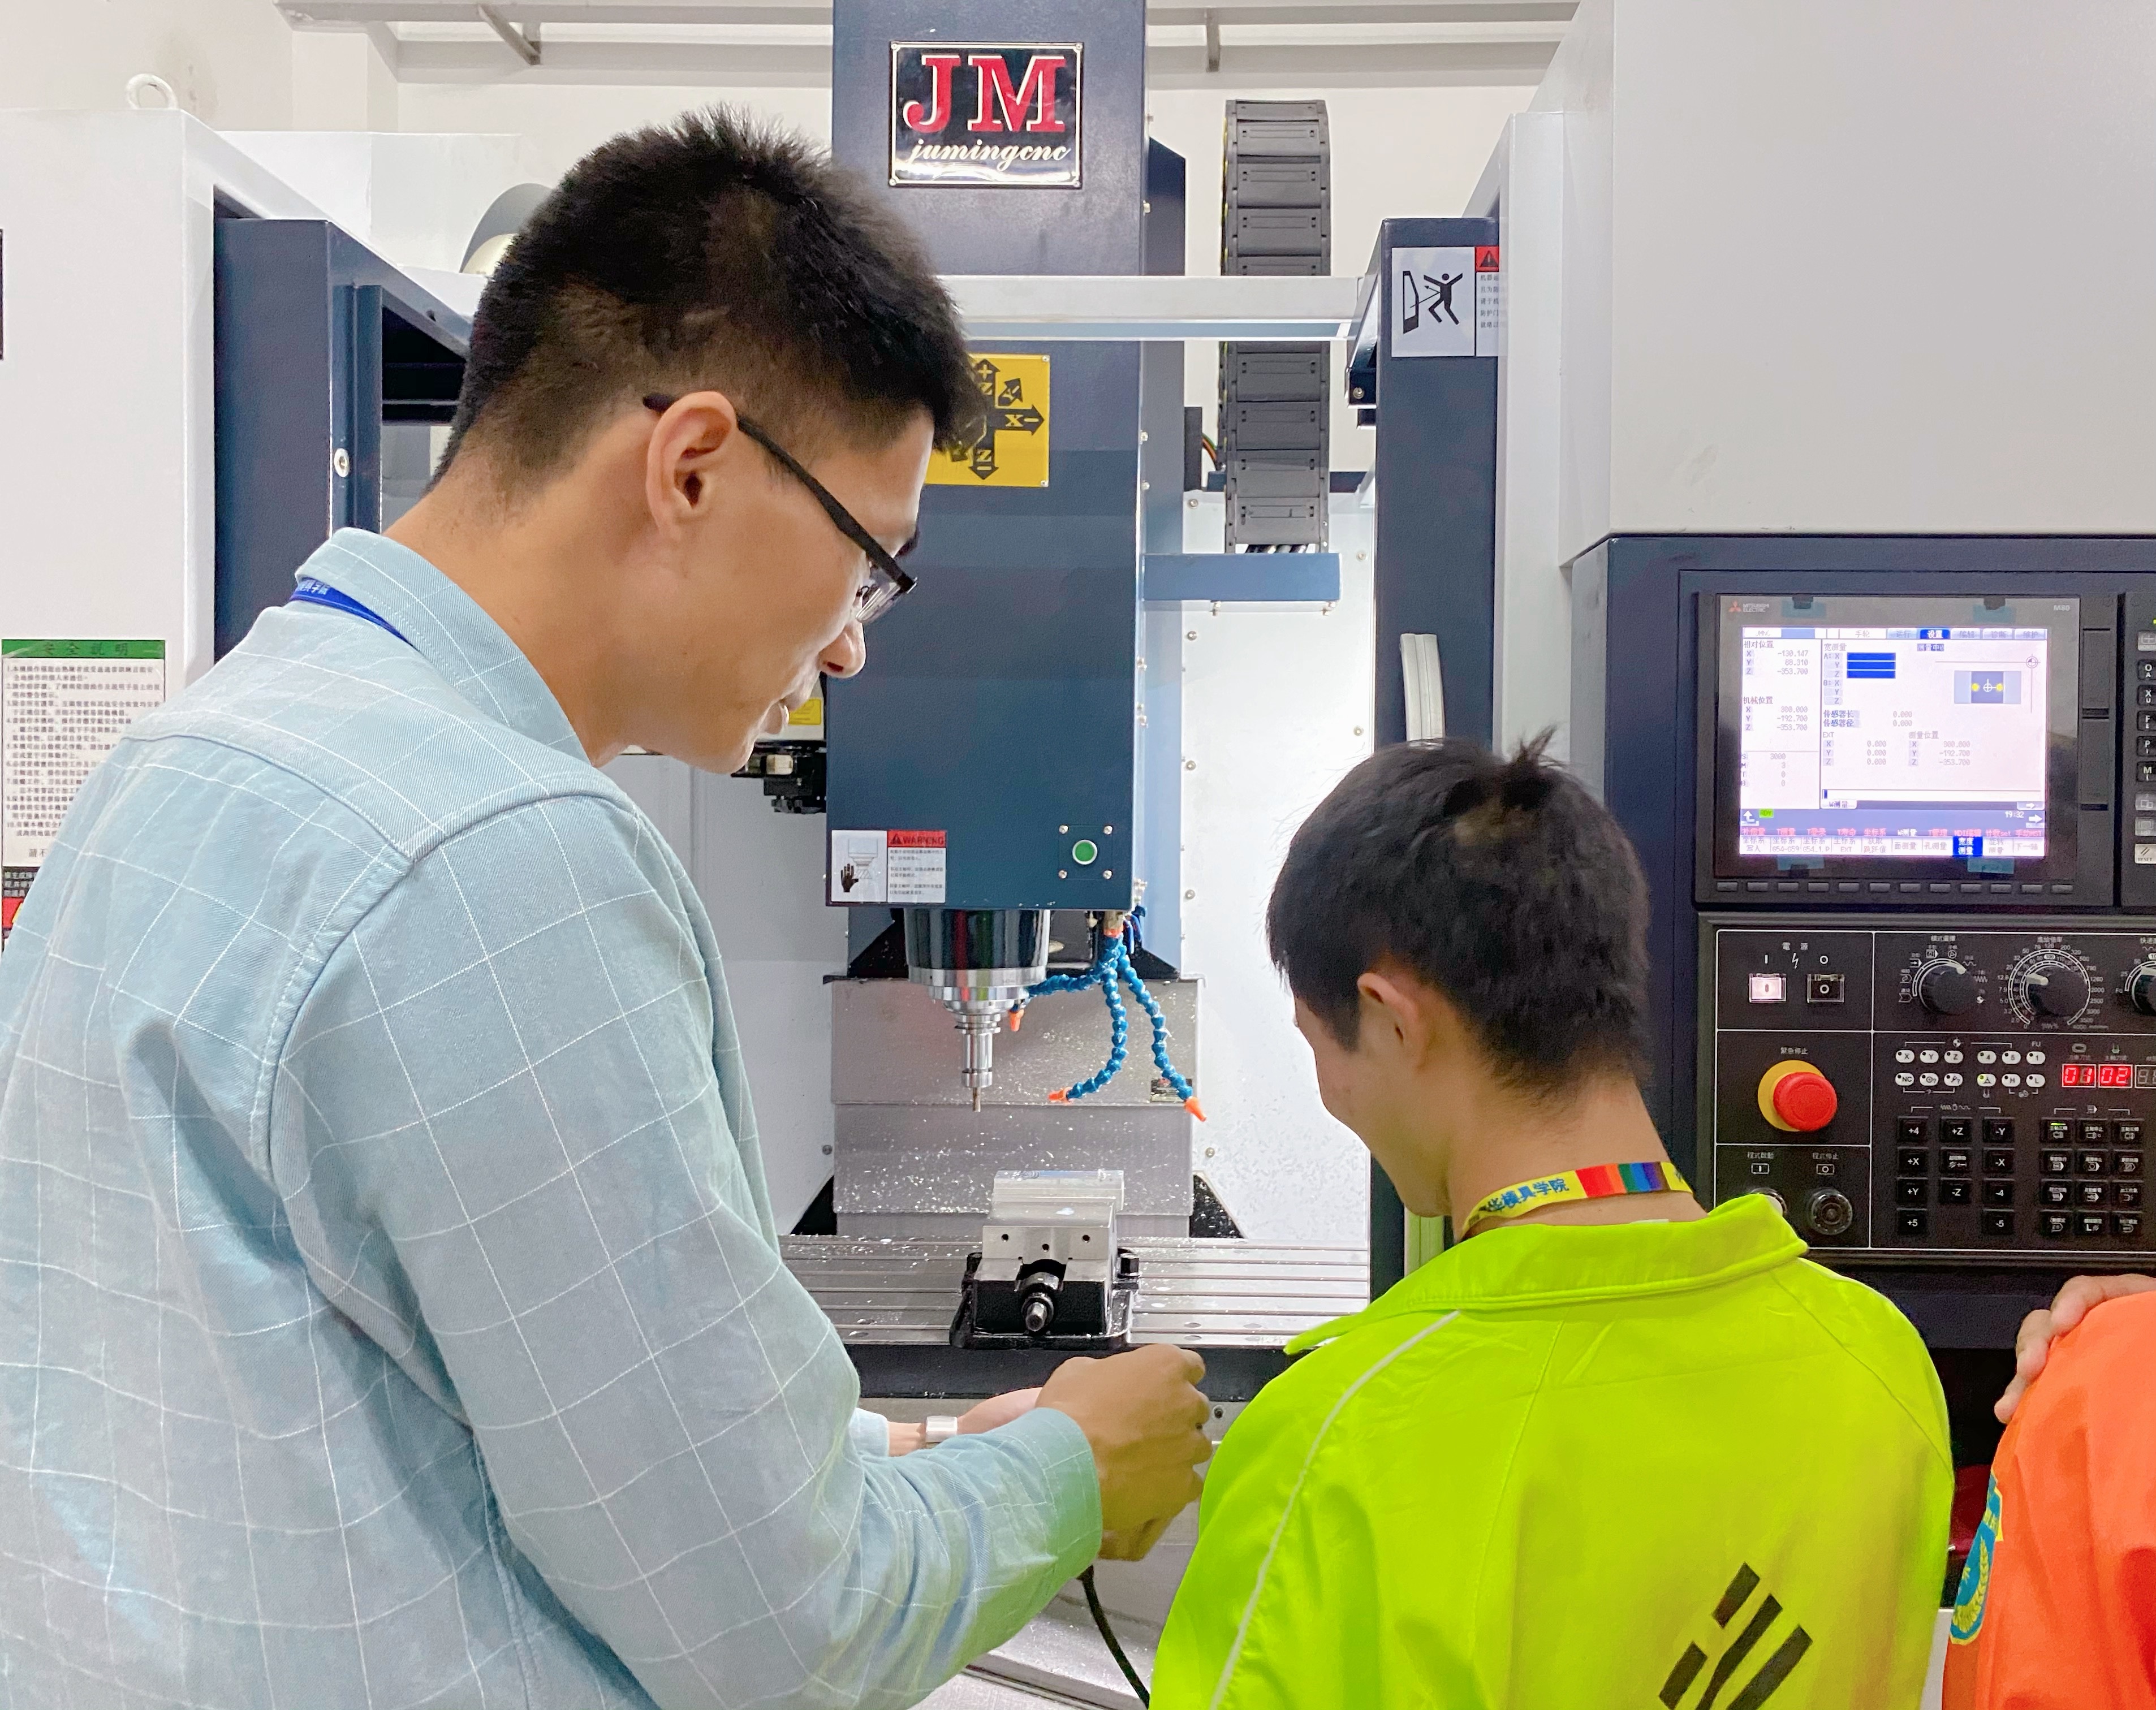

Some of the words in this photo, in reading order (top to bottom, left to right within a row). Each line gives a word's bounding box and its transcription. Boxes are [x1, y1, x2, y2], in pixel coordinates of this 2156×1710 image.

[903, 54, 1066, 133] JM
[909, 139, 1072, 172] jumingcnc
[1743, 640, 1774, 649] 相对位置
[1824, 643, 1847, 651] 宽测量
[1743, 696, 1773, 705] 机械位置
[1823, 710, 1855, 718] 传感器长
[1823, 719, 1855, 727] 传感器径
[1909, 731, 1939, 740] 测量位置
[903, 836, 944, 844] WARNING
[2064, 1068, 2093, 1083] 01
[2101, 1068, 2128, 1084] 02
